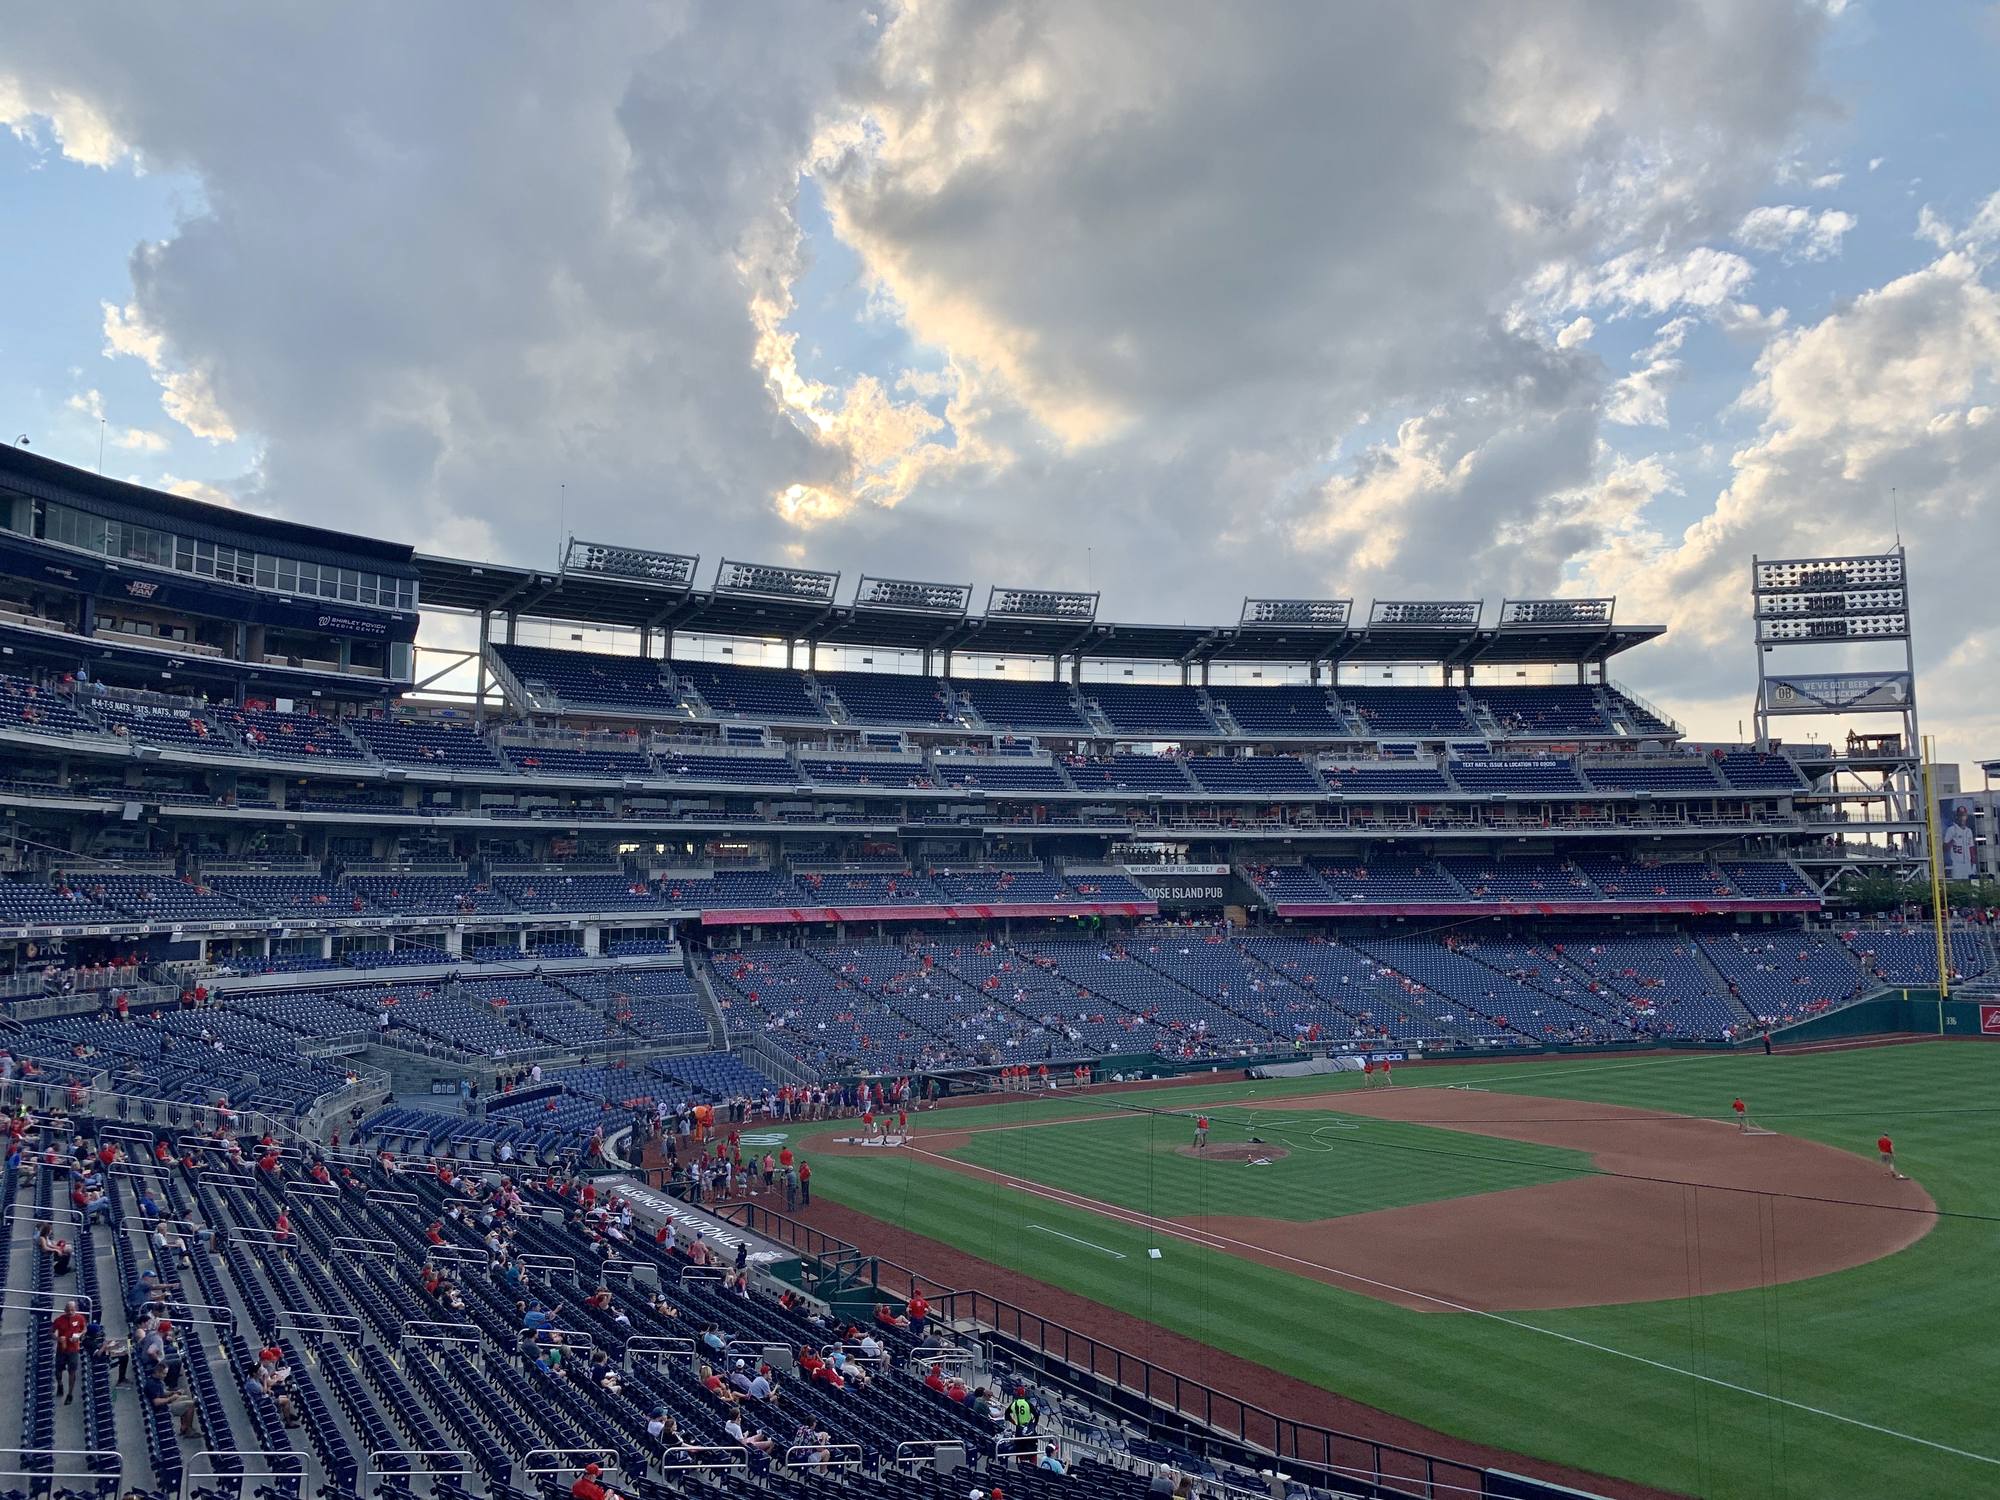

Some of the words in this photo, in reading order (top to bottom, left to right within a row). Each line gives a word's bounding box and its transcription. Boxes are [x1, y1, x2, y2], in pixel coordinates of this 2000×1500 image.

[131, 587, 154, 596] FAN
[332, 617, 360, 626] SHIRLEY
[361, 622, 386, 630] POVICH
[356, 626, 385, 634] CENTER
[1803, 681, 1828, 690] WE'VE
[1830, 681, 1846, 689] GOT
[152, 707, 171, 717] NATS,
[173, 710, 191, 718] WOO!
[1141, 865, 1151, 873] NOT
[1151, 865, 1170, 873] CHANGE
[1170, 865, 1177, 873] UP
[1177, 865, 1186, 873] THE
[1172, 887, 1204, 899] ISLAND
[1206, 887, 1223, 898] PUB
[39, 942, 68, 956] PNC
[1946, 1016, 1957, 1026] 336
[1372, 1053, 1402, 1062] GEICO
[612, 1183, 683, 1220] WASHINGTON
[674, 1213, 752, 1249] NATIONALS
